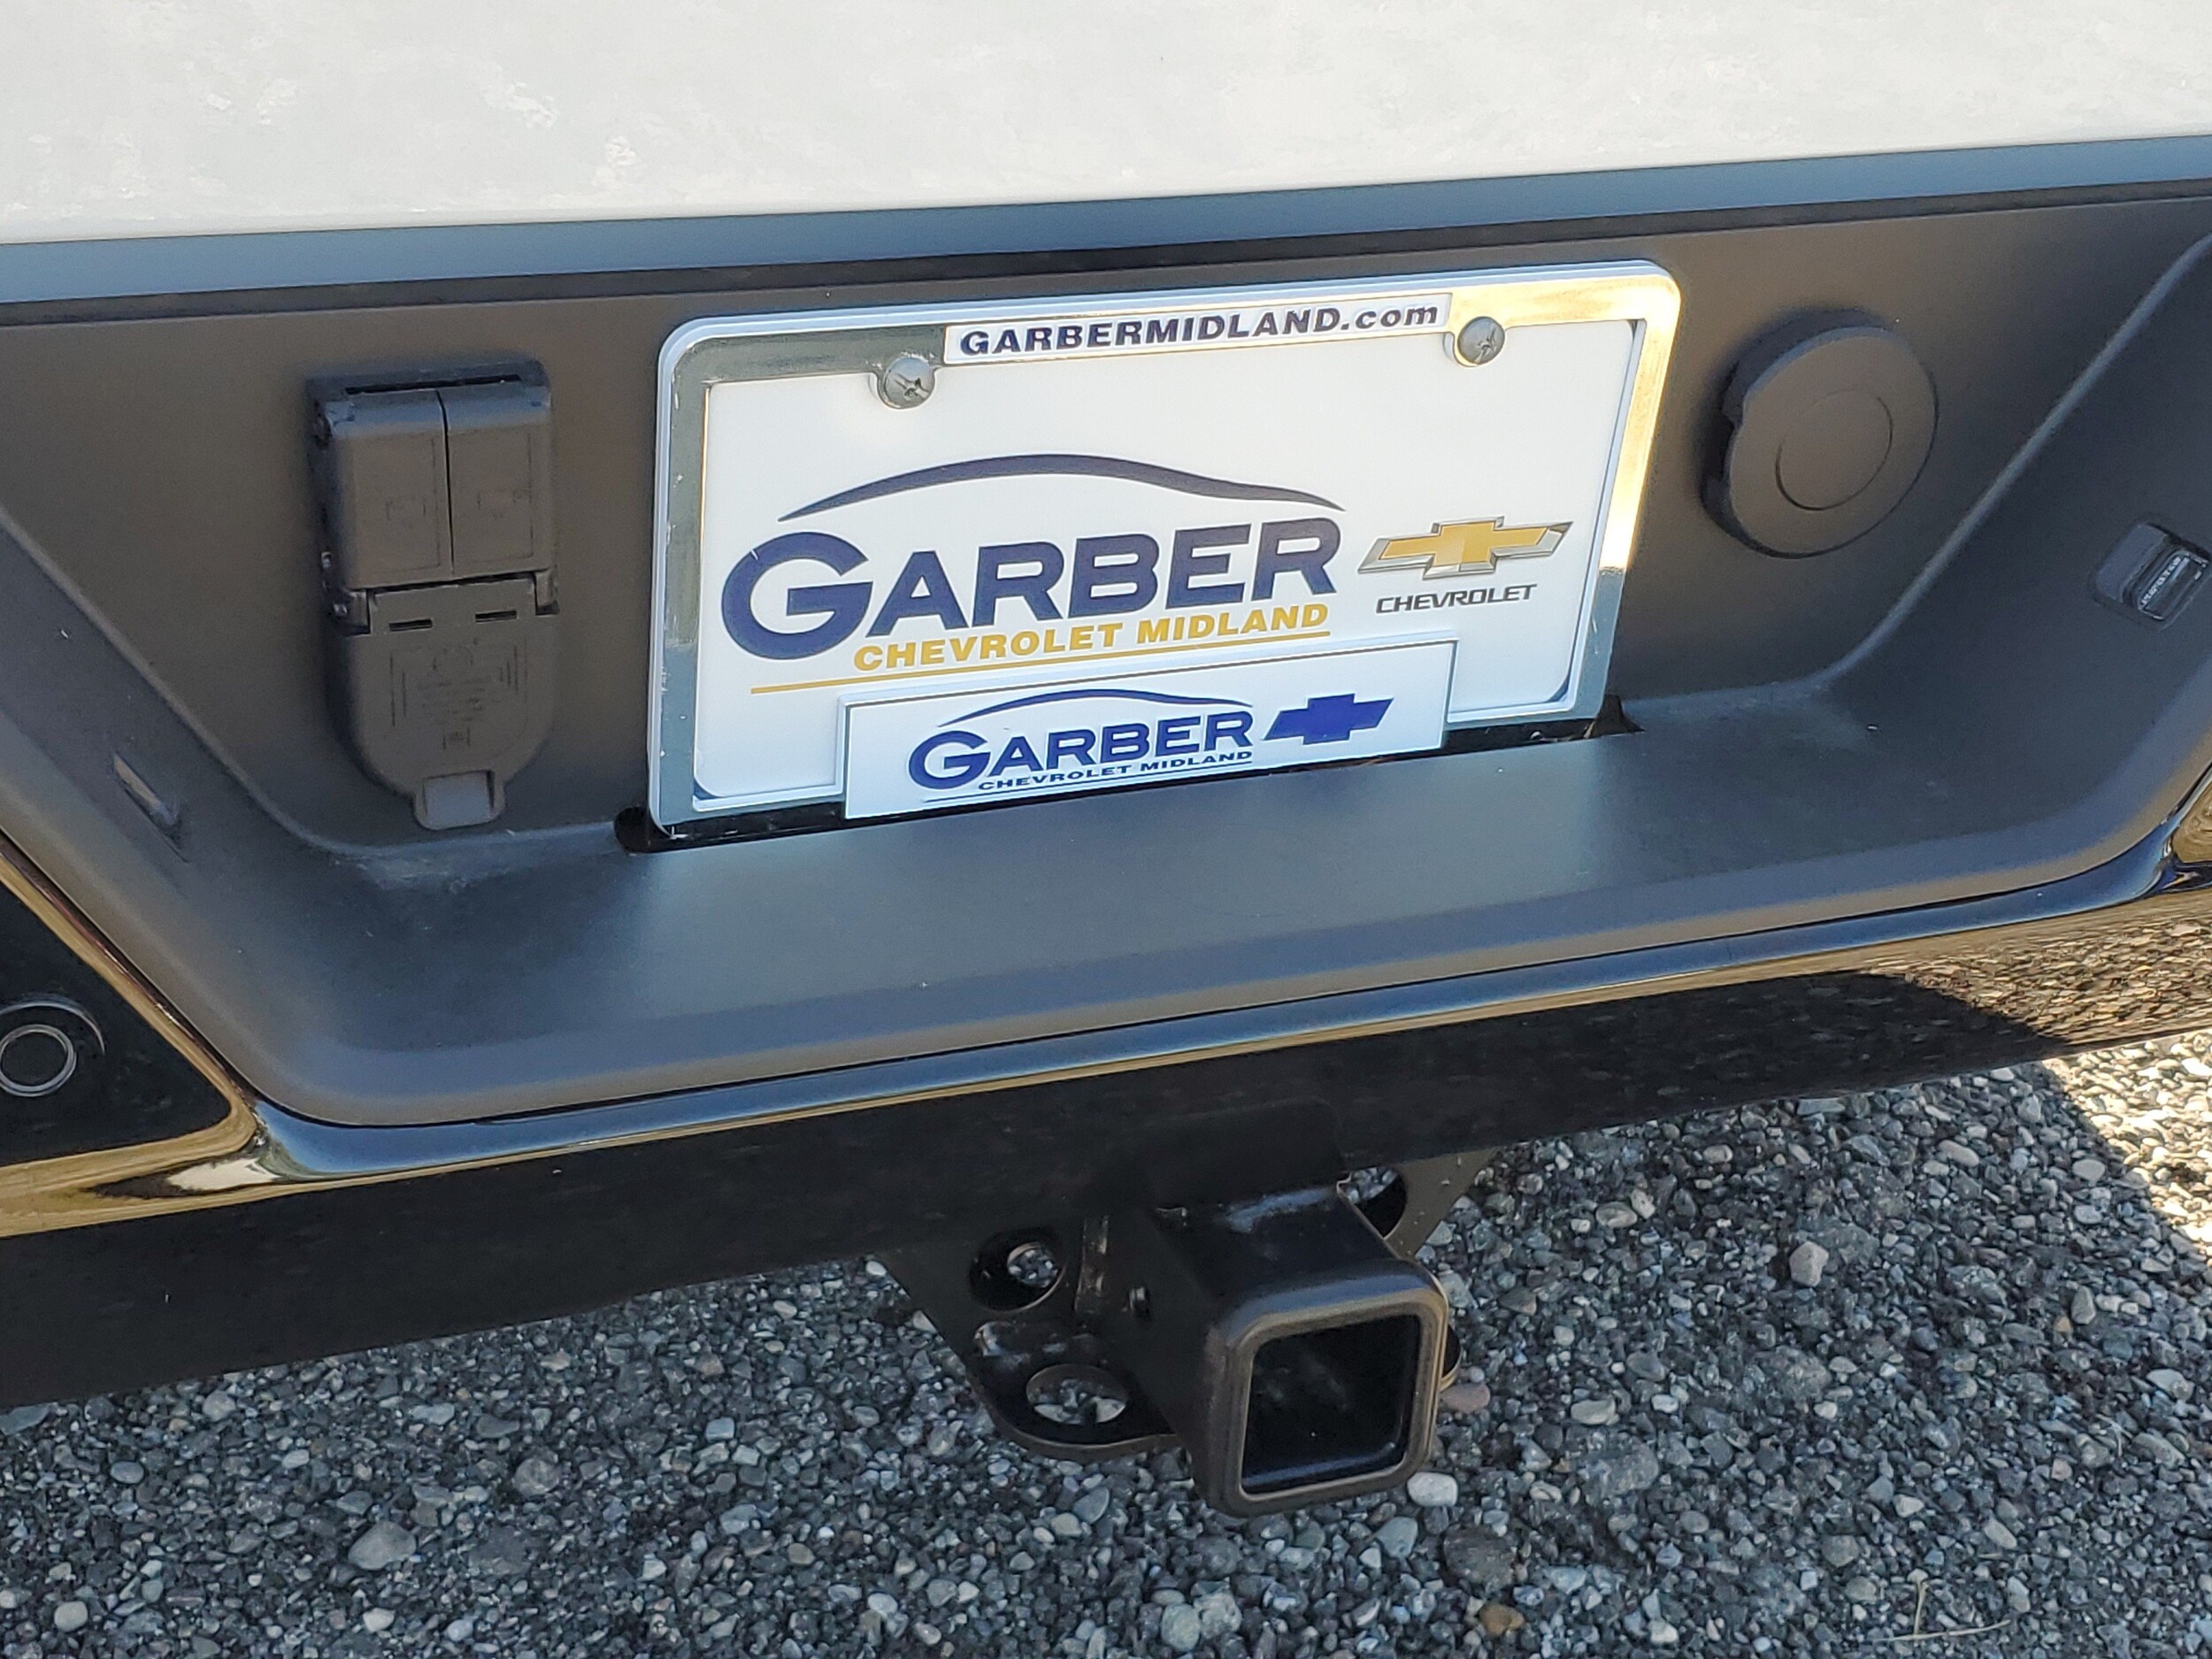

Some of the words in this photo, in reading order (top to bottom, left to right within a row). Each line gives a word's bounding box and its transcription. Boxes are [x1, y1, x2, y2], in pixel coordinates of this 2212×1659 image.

[960, 305, 1439, 355] GARBERMIDLAND.com
[720, 517, 1342, 660] GARBER
[1376, 584, 1538, 613] CHEVROLET
[854, 622, 1123, 672] CHEVROLET
[1137, 603, 1329, 643] MIDLAND
[908, 710, 1254, 790] GARBER
[978, 765, 1133, 790] CHEVROLET
[1140, 750, 1253, 772] MIDLAND
